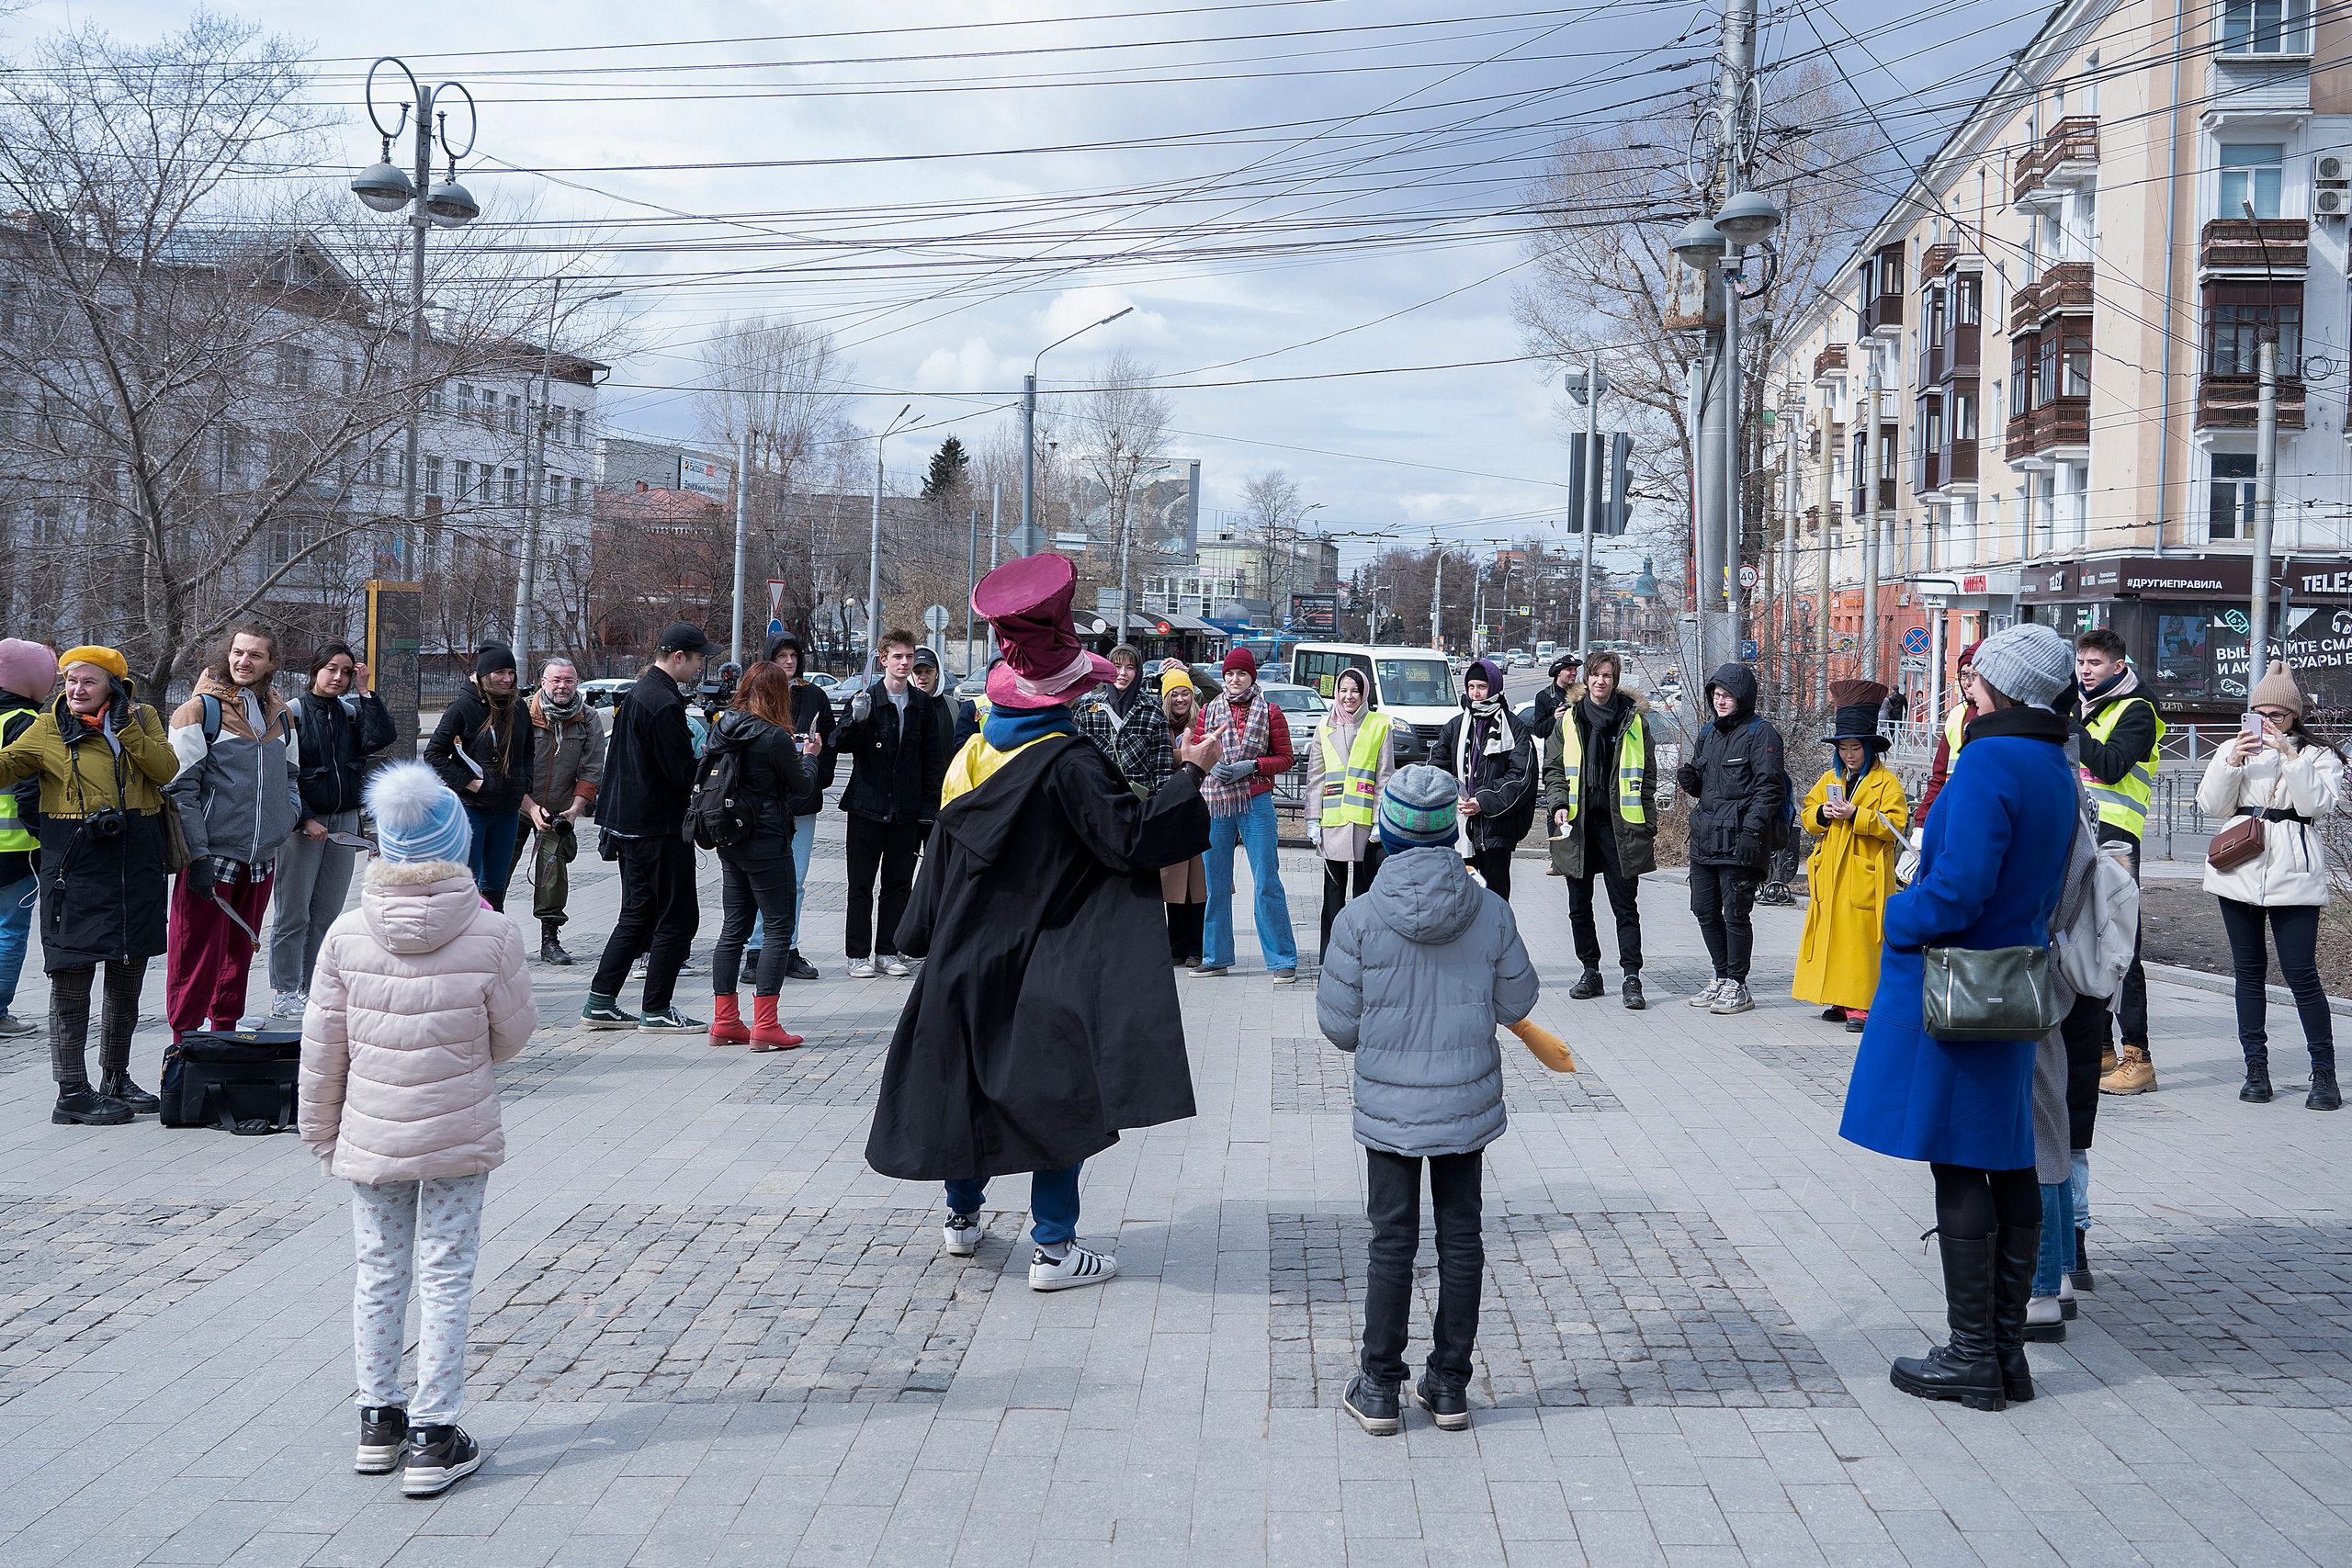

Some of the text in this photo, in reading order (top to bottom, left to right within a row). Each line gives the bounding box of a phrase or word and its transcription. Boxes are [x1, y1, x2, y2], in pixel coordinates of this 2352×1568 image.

[1741, 571, 1754, 581] 40
[1963, 575, 1986, 592] ОПТИКА
[2127, 578, 2222, 590] #ДРУГИЕПРАВИЛА
[2217, 662, 2229, 675] И
